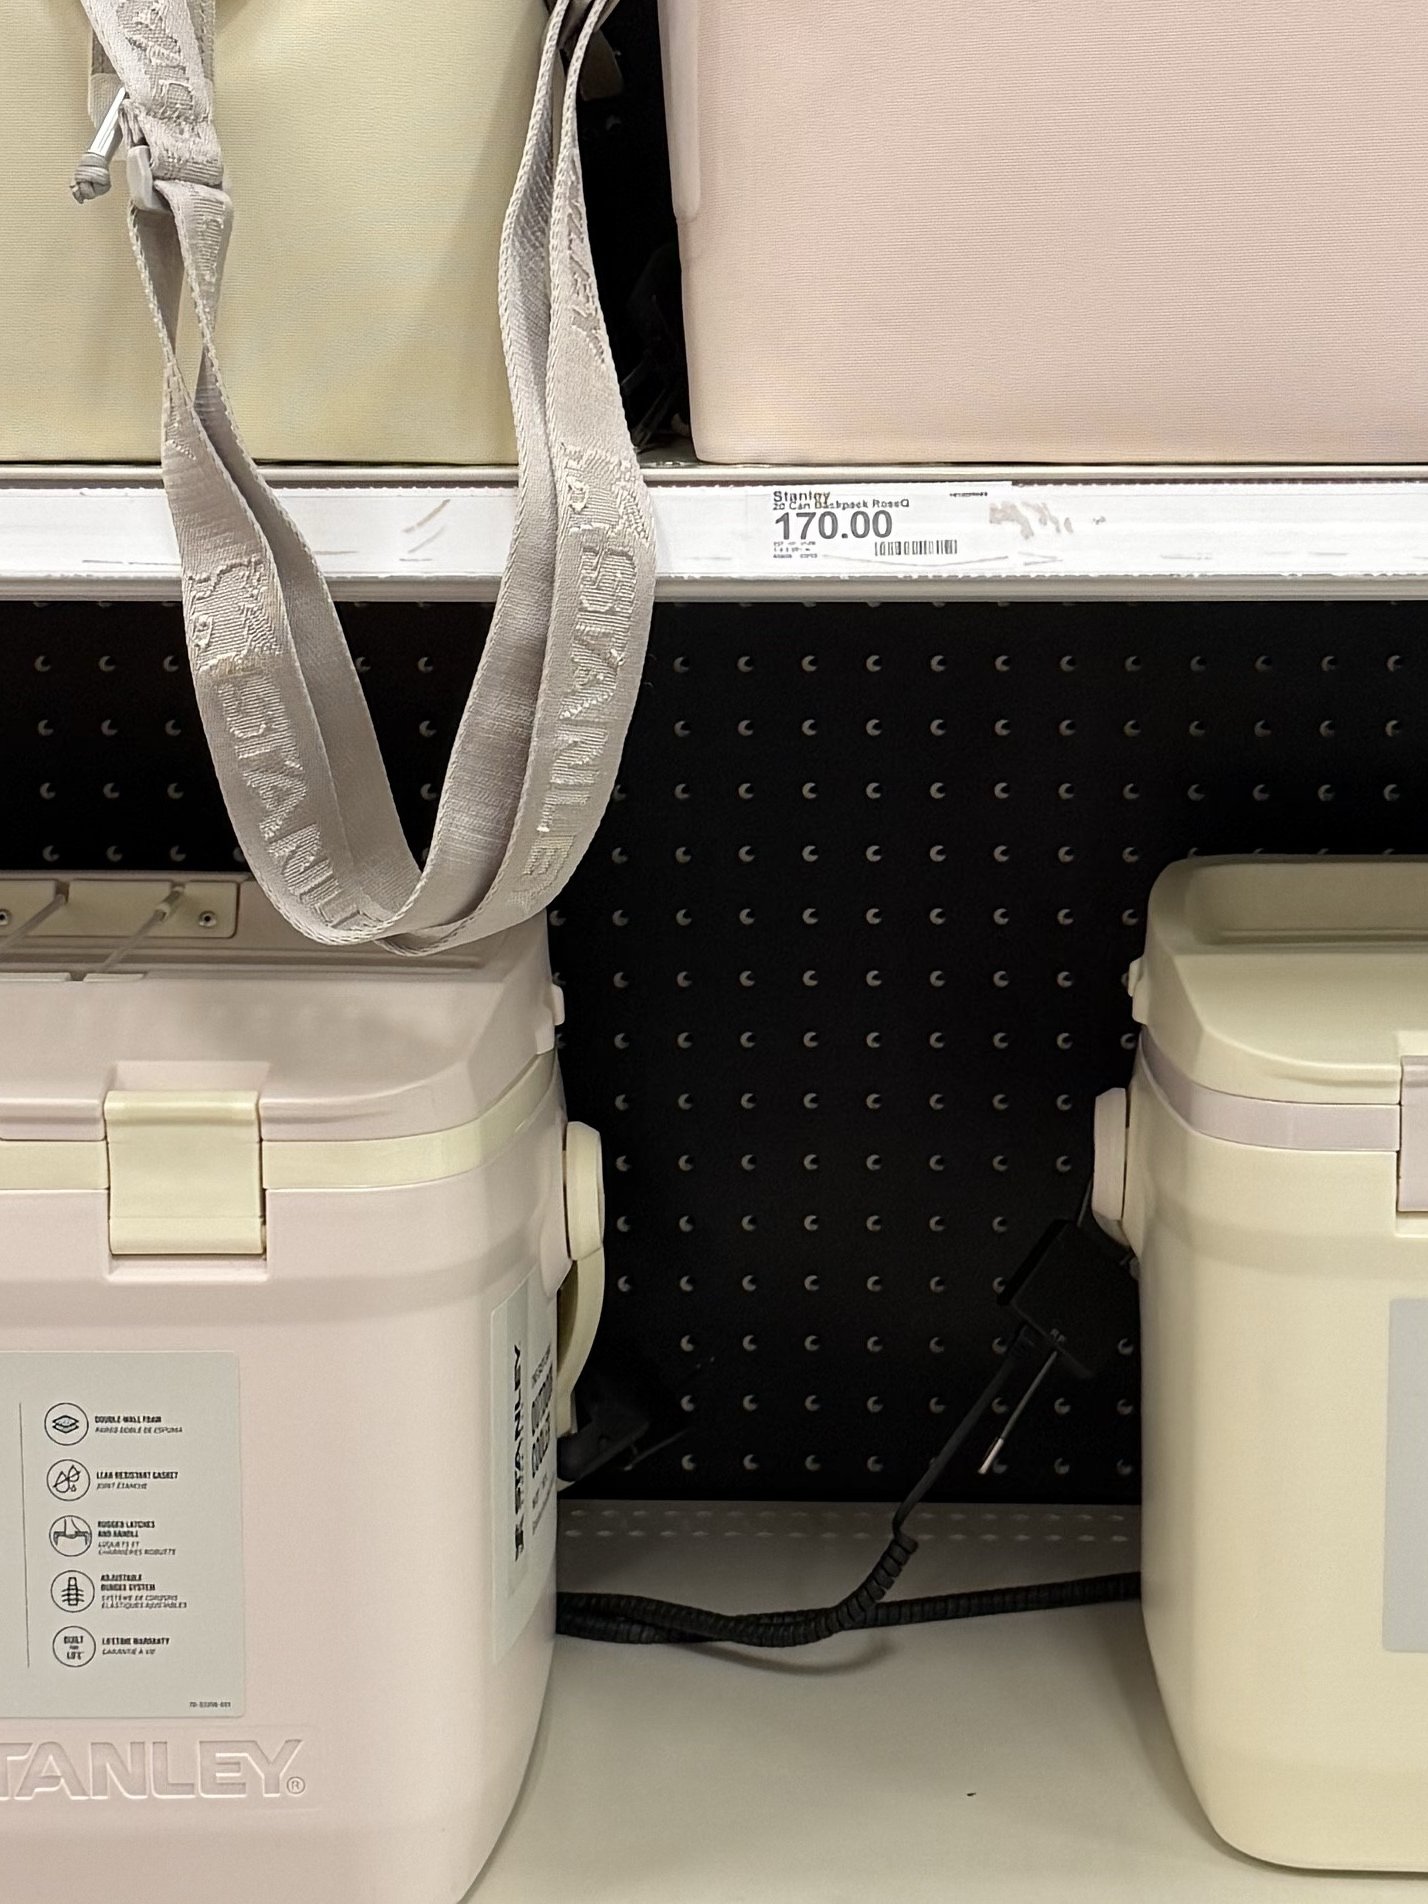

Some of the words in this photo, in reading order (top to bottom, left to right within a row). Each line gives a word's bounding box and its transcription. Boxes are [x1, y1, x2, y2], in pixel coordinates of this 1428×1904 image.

[773, 490, 831, 504] Stanley
[772, 501, 786, 511] 20
[775, 510, 893, 540] 170.00
